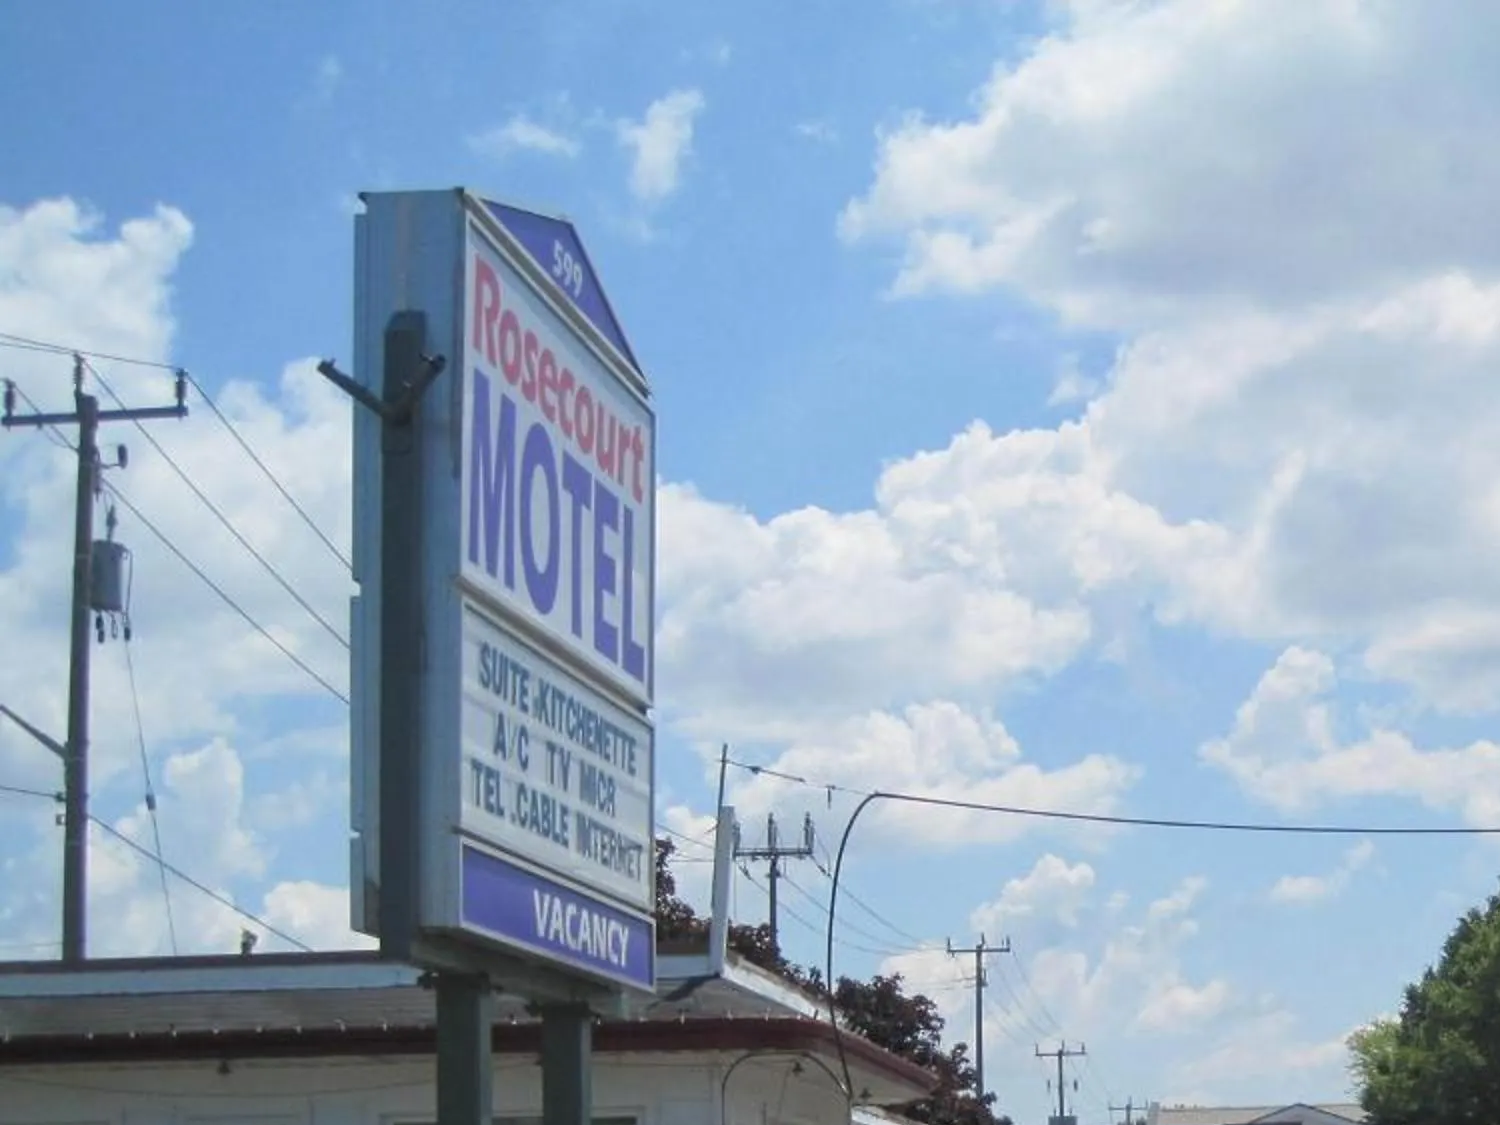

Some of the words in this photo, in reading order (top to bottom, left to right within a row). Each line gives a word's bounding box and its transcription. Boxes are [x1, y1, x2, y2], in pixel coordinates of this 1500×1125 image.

[552, 240, 583, 298] 599
[472, 254, 644, 504] Rosecourt
[469, 367, 645, 683] MOTEL
[478, 641, 531, 713] SUITE
[493, 712, 529, 771] A/C
[546, 742, 571, 792] TV
[579, 759, 616, 818] MICR
[577, 812, 643, 881] INTERNET
[533, 889, 629, 968] VACANCY
